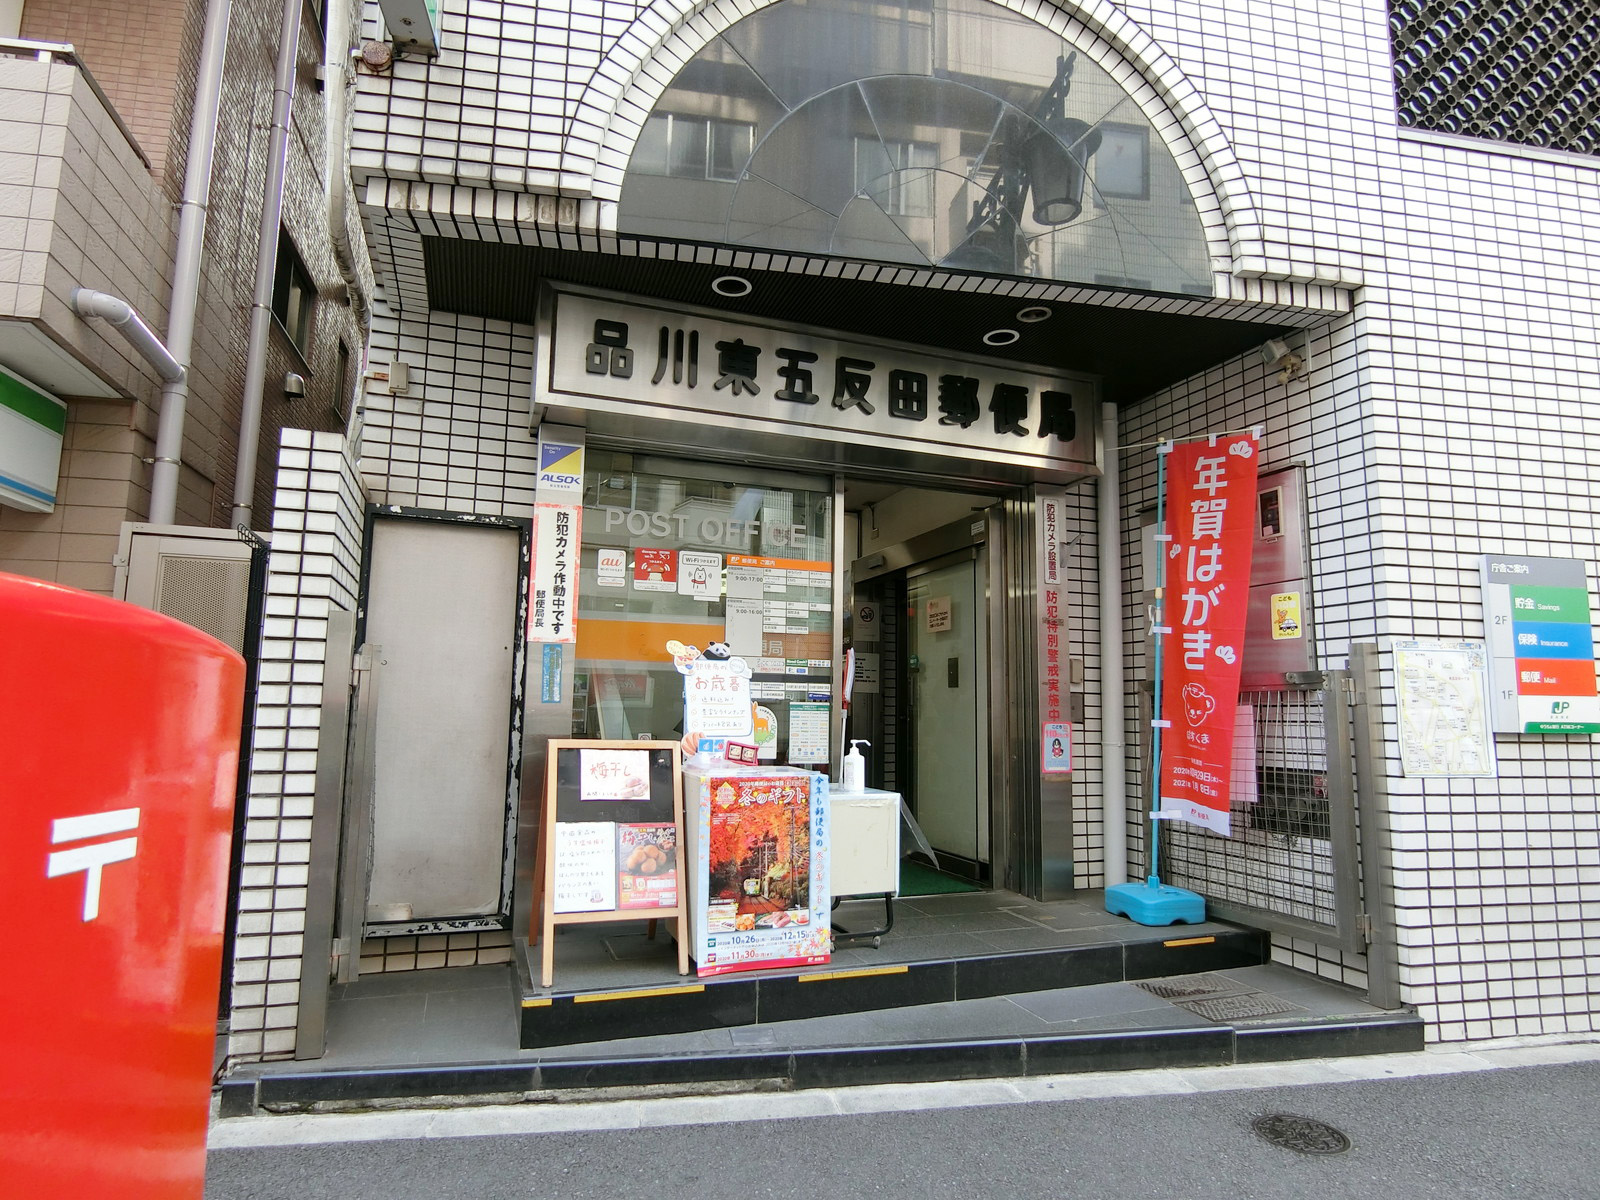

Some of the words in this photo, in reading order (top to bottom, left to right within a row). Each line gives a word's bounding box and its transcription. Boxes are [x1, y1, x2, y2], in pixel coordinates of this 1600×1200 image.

[586, 318, 1077, 443] 品川東五反田郵便局
[541, 474, 581, 485] ALSOK
[604, 506, 691, 540] POST
[701, 517, 807, 549] OFFICE
[1046, 503, 1057, 581] 防犯カメラ設置局
[601, 557, 622, 567] au
[1181, 455, 1228, 671] 年賀はがき
[1491, 562, 1530, 574] 庁舎ご案内
[551, 511, 570, 635] 防犯カメラ作動中です
[534, 589, 546, 628] 郵便局長
[1514, 597, 1535, 610] 貯金
[1537, 603, 1560, 612] Savings
[1494, 616, 1508, 625] 2F
[1517, 633, 1538, 646] 保険
[1540, 639, 1569, 647] Insurance
[1046, 590, 1060, 722] 防犯特別警戒実施中
[695, 674, 740, 692] お歳暮
[1520, 670, 1541, 684] 郵便
[1502, 690, 1514, 699] 1F
[1551, 701, 1570, 715] JP
[738, 787, 806, 806] 冬のギフト
